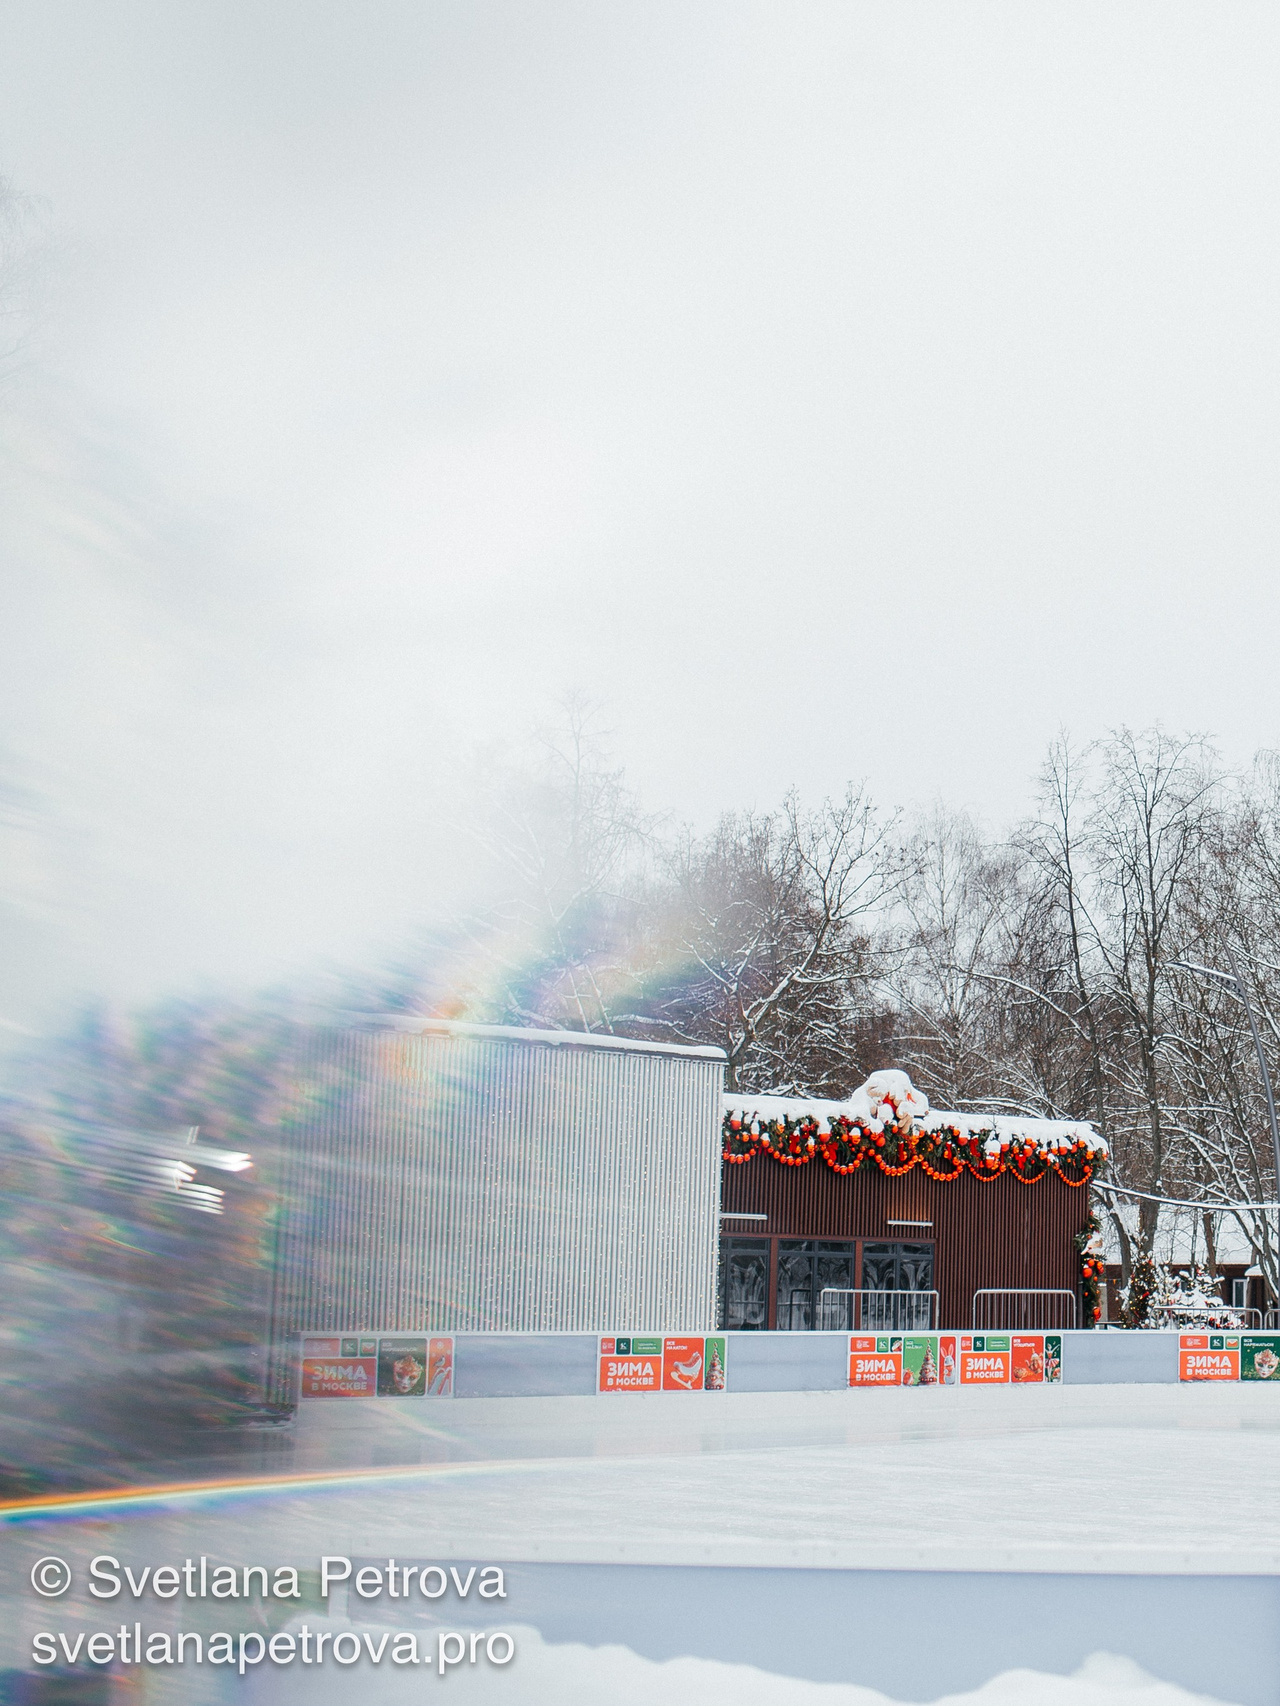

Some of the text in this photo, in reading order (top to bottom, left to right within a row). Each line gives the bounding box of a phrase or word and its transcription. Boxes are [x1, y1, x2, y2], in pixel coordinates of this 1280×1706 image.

[856, 1359, 896, 1372] ЗИМА
[966, 1358, 1004, 1370] ЗИМА
[1187, 1355, 1232, 1367] ЗИМА
[312, 1365, 367, 1381] ЗИМА
[607, 1362, 654, 1377] ЗИМА
[973, 1371, 1004, 1379] МОСКВЕ
[607, 1377, 654, 1386] В МОСКВЕ
[863, 1373, 896, 1381] МОСКВЕ
[312, 1381, 367, 1391] В МОСКВЕ
